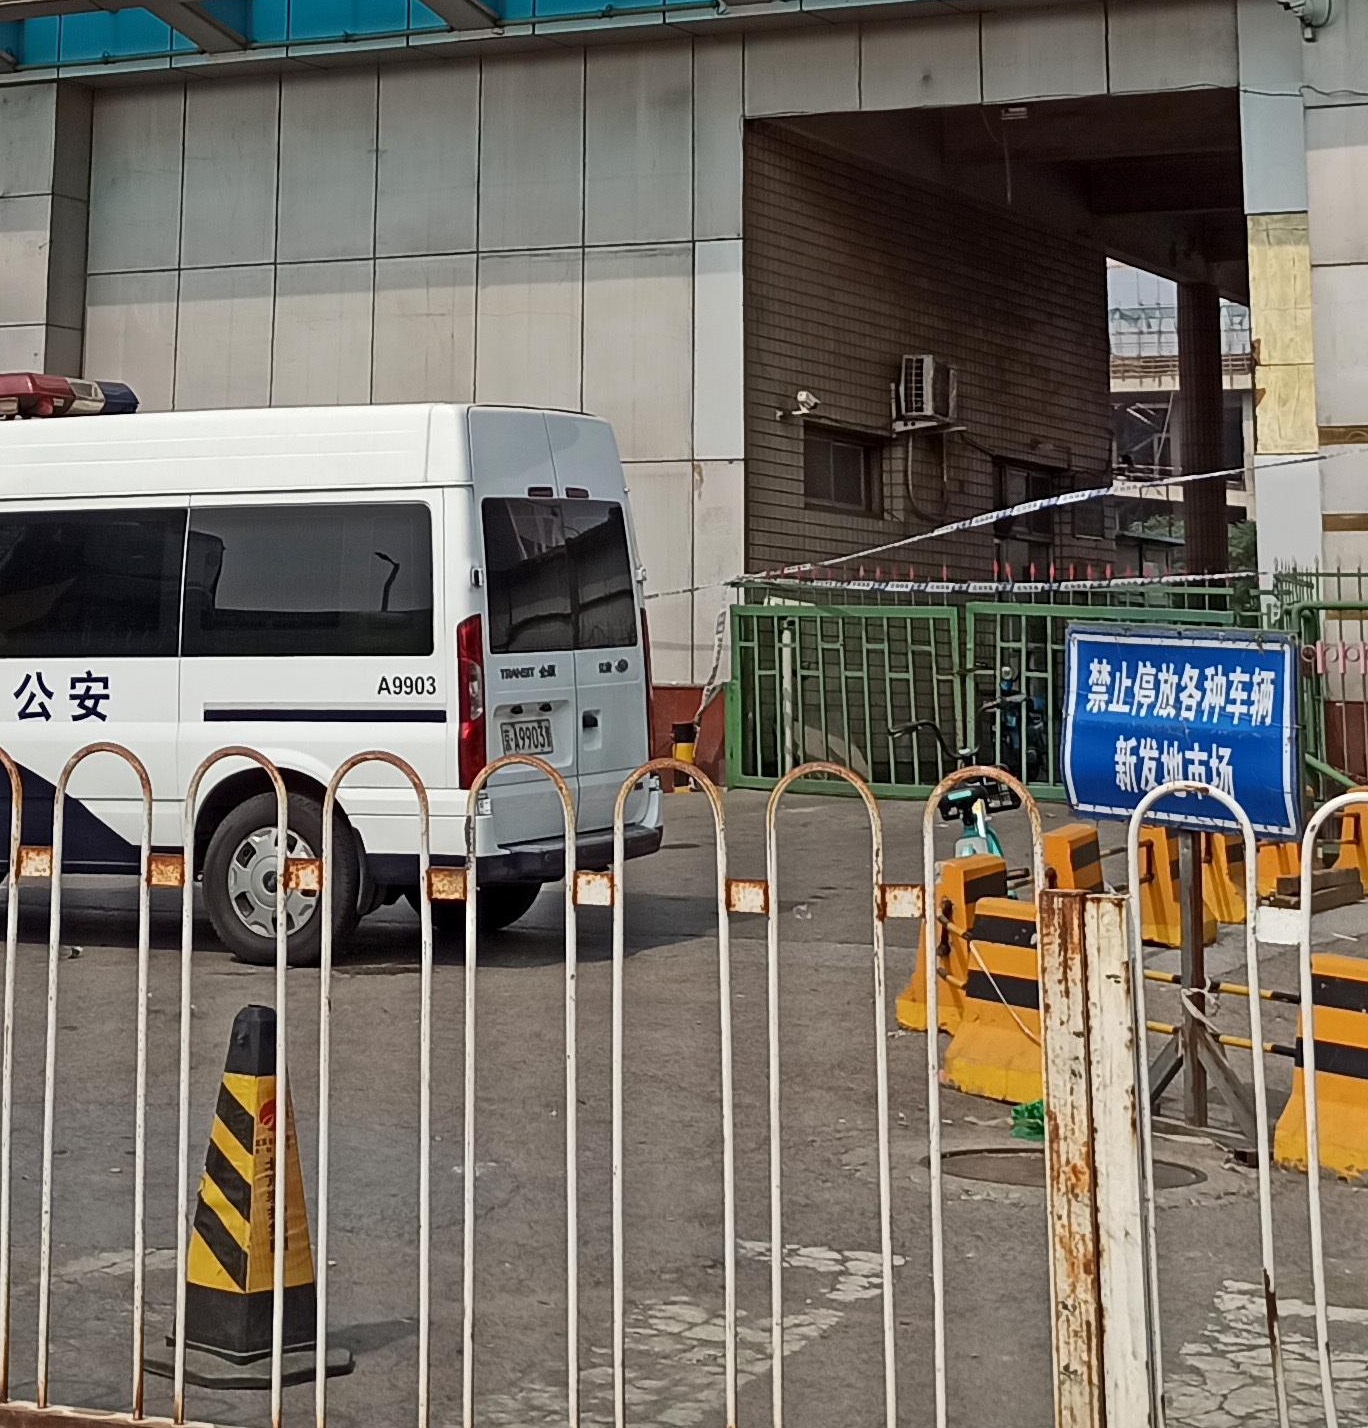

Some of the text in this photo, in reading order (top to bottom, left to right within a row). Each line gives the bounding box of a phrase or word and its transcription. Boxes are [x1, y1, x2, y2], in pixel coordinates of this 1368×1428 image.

[13, 670, 110, 722] 公安
[377, 676, 436, 695] A9903
[1086, 658, 1276, 727] 禁止停放各种车辆
[1114, 735, 1235, 800] 新发地市场
